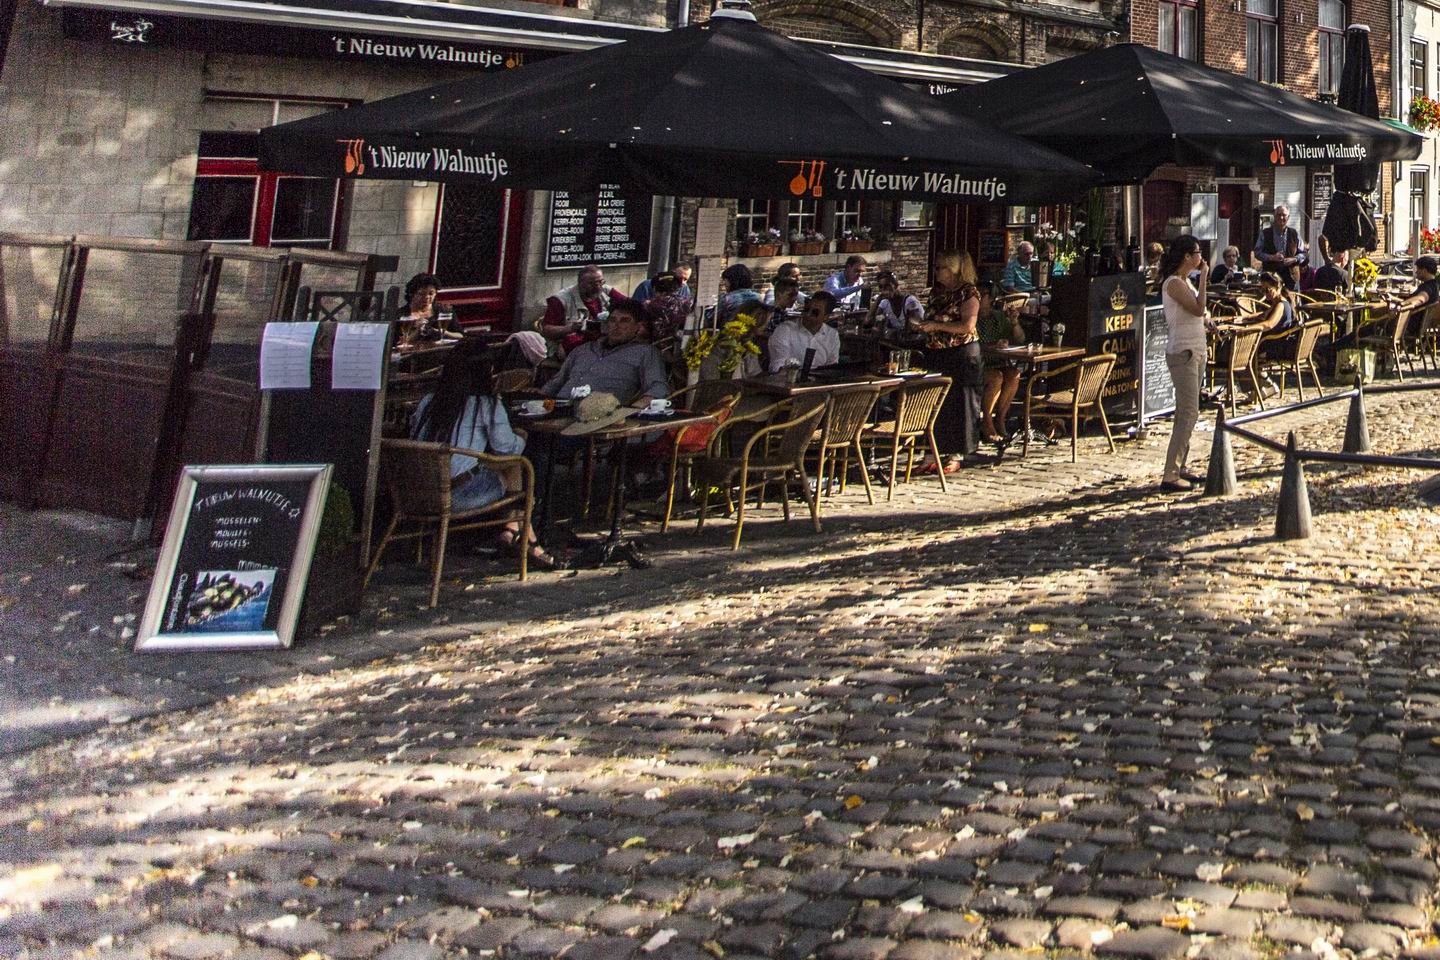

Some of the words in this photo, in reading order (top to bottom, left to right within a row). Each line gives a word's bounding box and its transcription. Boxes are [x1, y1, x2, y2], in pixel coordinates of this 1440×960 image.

[332, 36, 344, 53] 't
[350, 39, 415, 58] Nieuw
[418, 44, 503, 68] Walnutje
[1286, 143, 1294, 159] 't
[1295, 143, 1326, 159] Nieuw
[1325, 143, 1367, 161] Walnutje
[368, 145, 378, 168] 't
[381, 146, 431, 170] Nieuw
[432, 147, 509, 182] Walnutje
[834, 167, 847, 190] 't
[850, 168, 920, 191] Nieuw
[923, 171, 1007, 202] Walnutje
[552, 226, 584, 235] PASTIS-ROOM
[553, 218, 584, 226] KERRY-ROOM
[552, 236, 576, 244] KRIEKBIER
[551, 245, 584, 253] KERVEL-ROOM
[1105, 313, 1133, 333] KEEP
[1102, 337, 1135, 354] CALM
